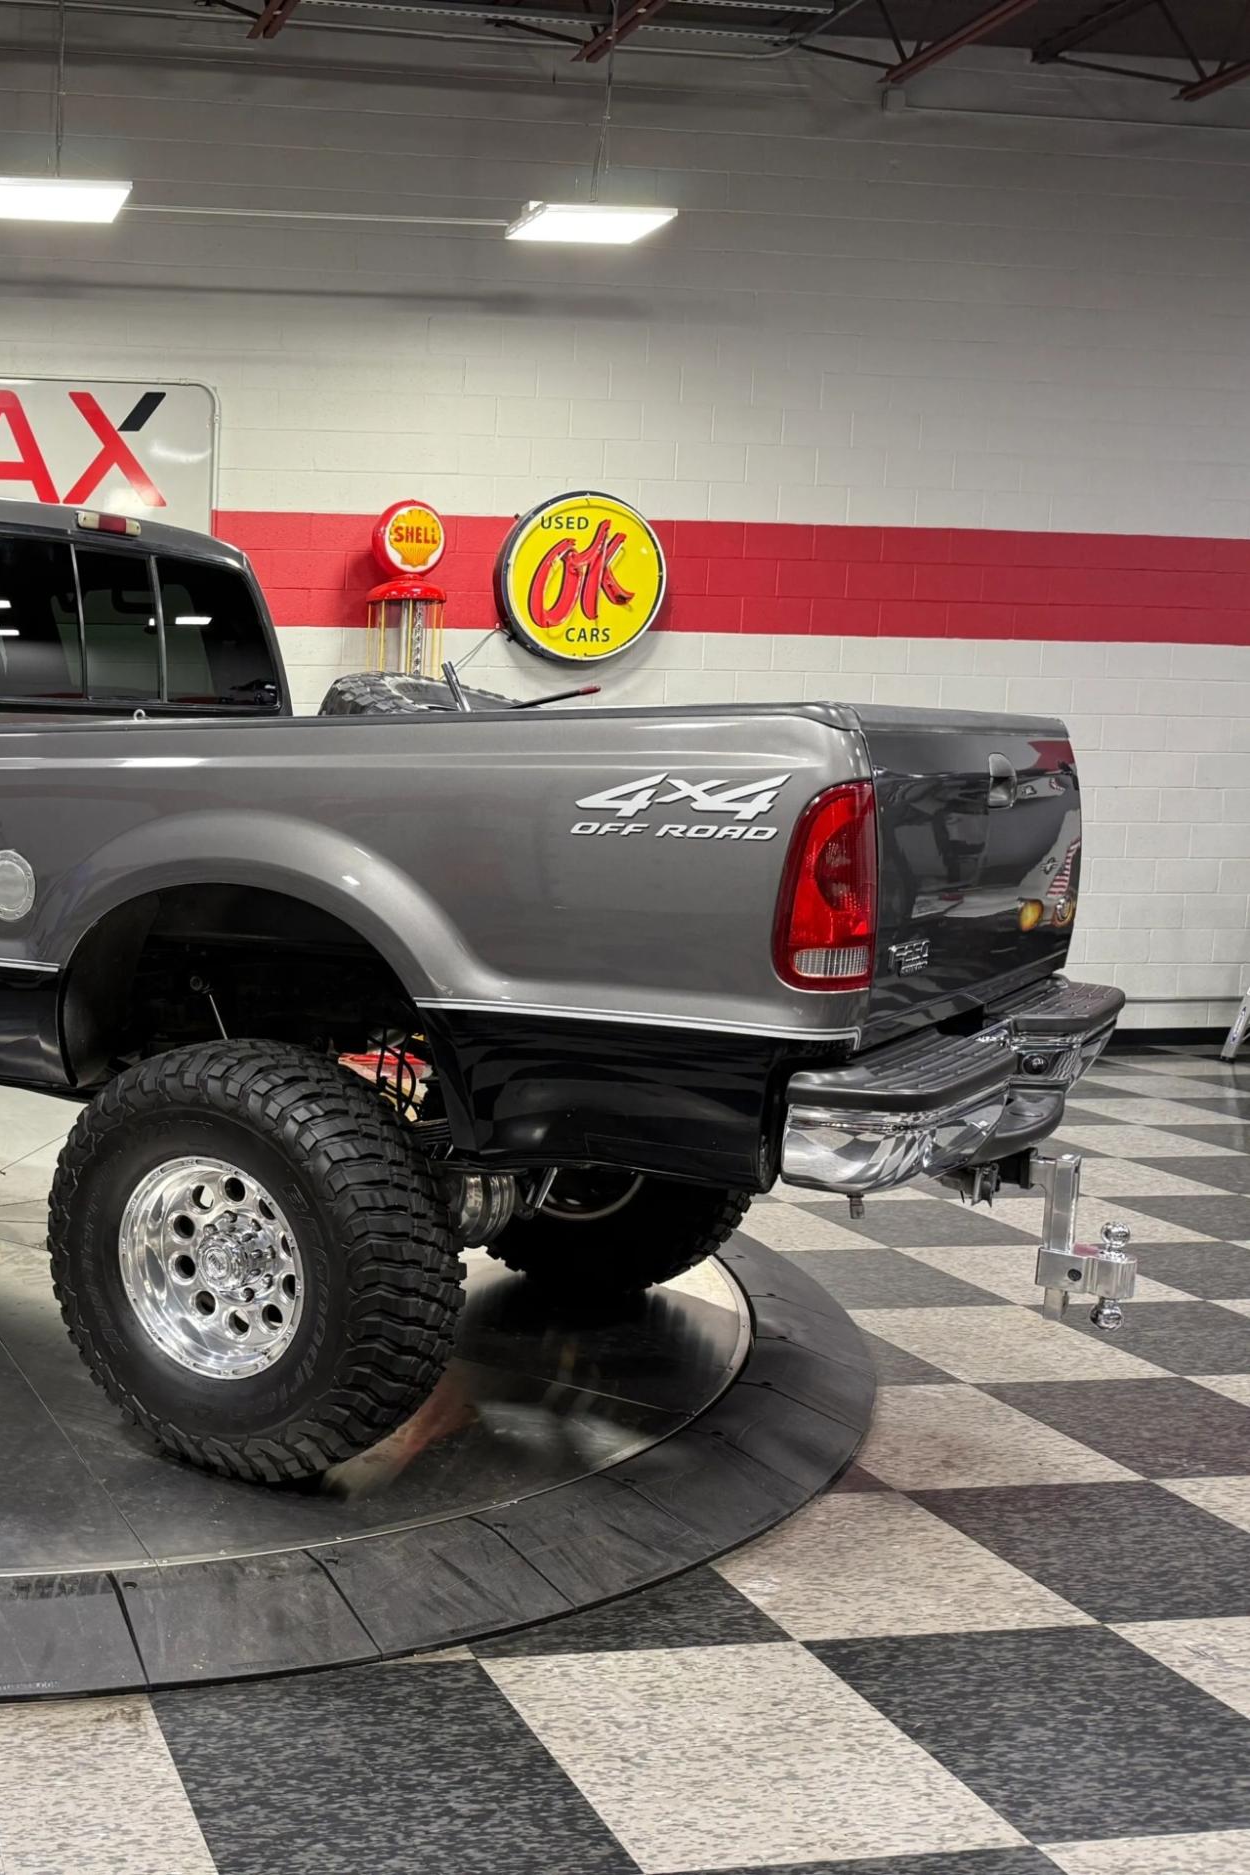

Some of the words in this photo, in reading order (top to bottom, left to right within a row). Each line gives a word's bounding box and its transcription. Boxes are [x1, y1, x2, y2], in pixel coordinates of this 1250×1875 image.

[540, 515, 589, 531] USED
[393, 525, 438, 546] SHELL
[528, 519, 635, 628] OK
[565, 627, 611, 643] CARS
[570, 822, 649, 836] OFF
[655, 824, 778, 841] ROAD
